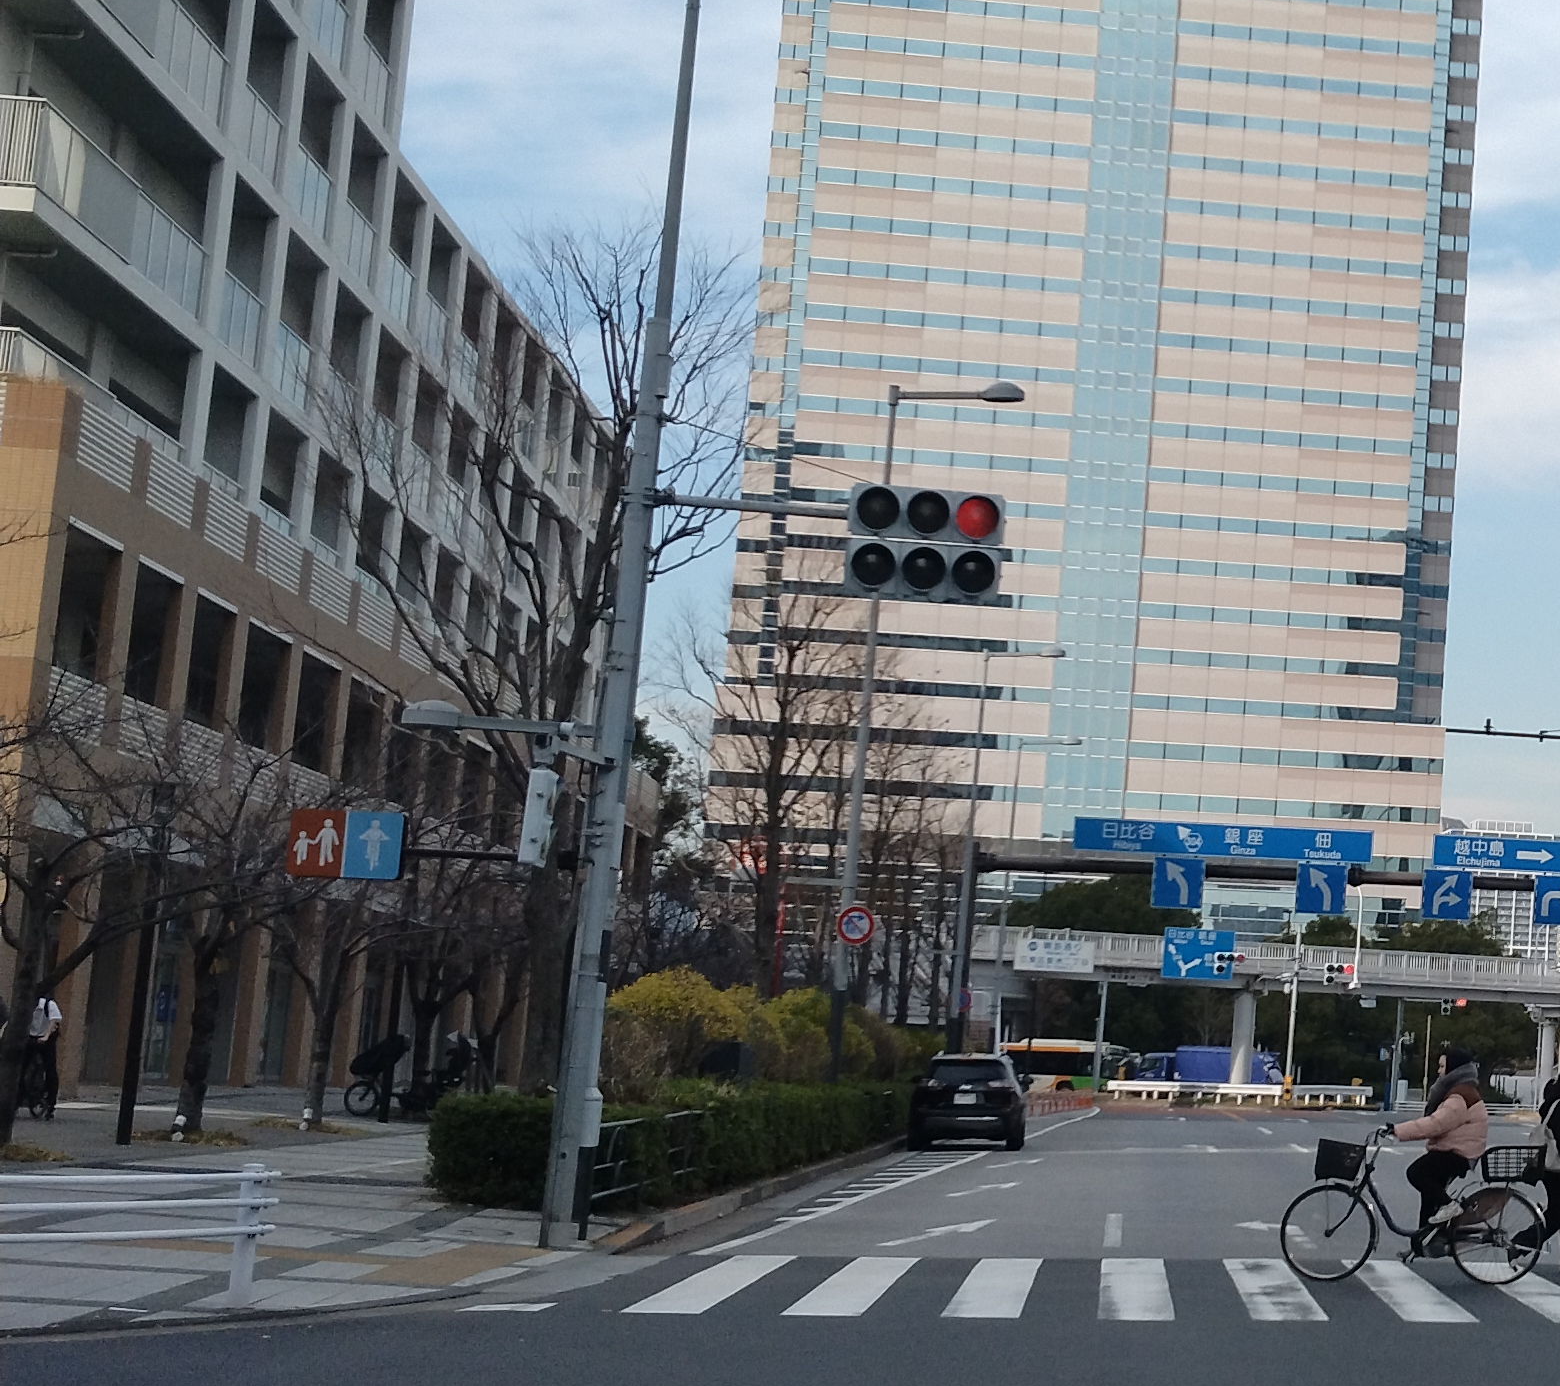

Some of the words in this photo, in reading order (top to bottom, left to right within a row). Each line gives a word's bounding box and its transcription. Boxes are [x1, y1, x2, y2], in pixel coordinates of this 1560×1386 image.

[1102, 822, 1156, 840] 日比谷
[1223, 827, 1264, 845] 銀座
[1315, 832, 1332, 849] 佃
[1453, 838, 1505, 857] 越中島
[1230, 845, 1257, 855] Ginza
[1303, 848, 1342, 859] Tsukuda
